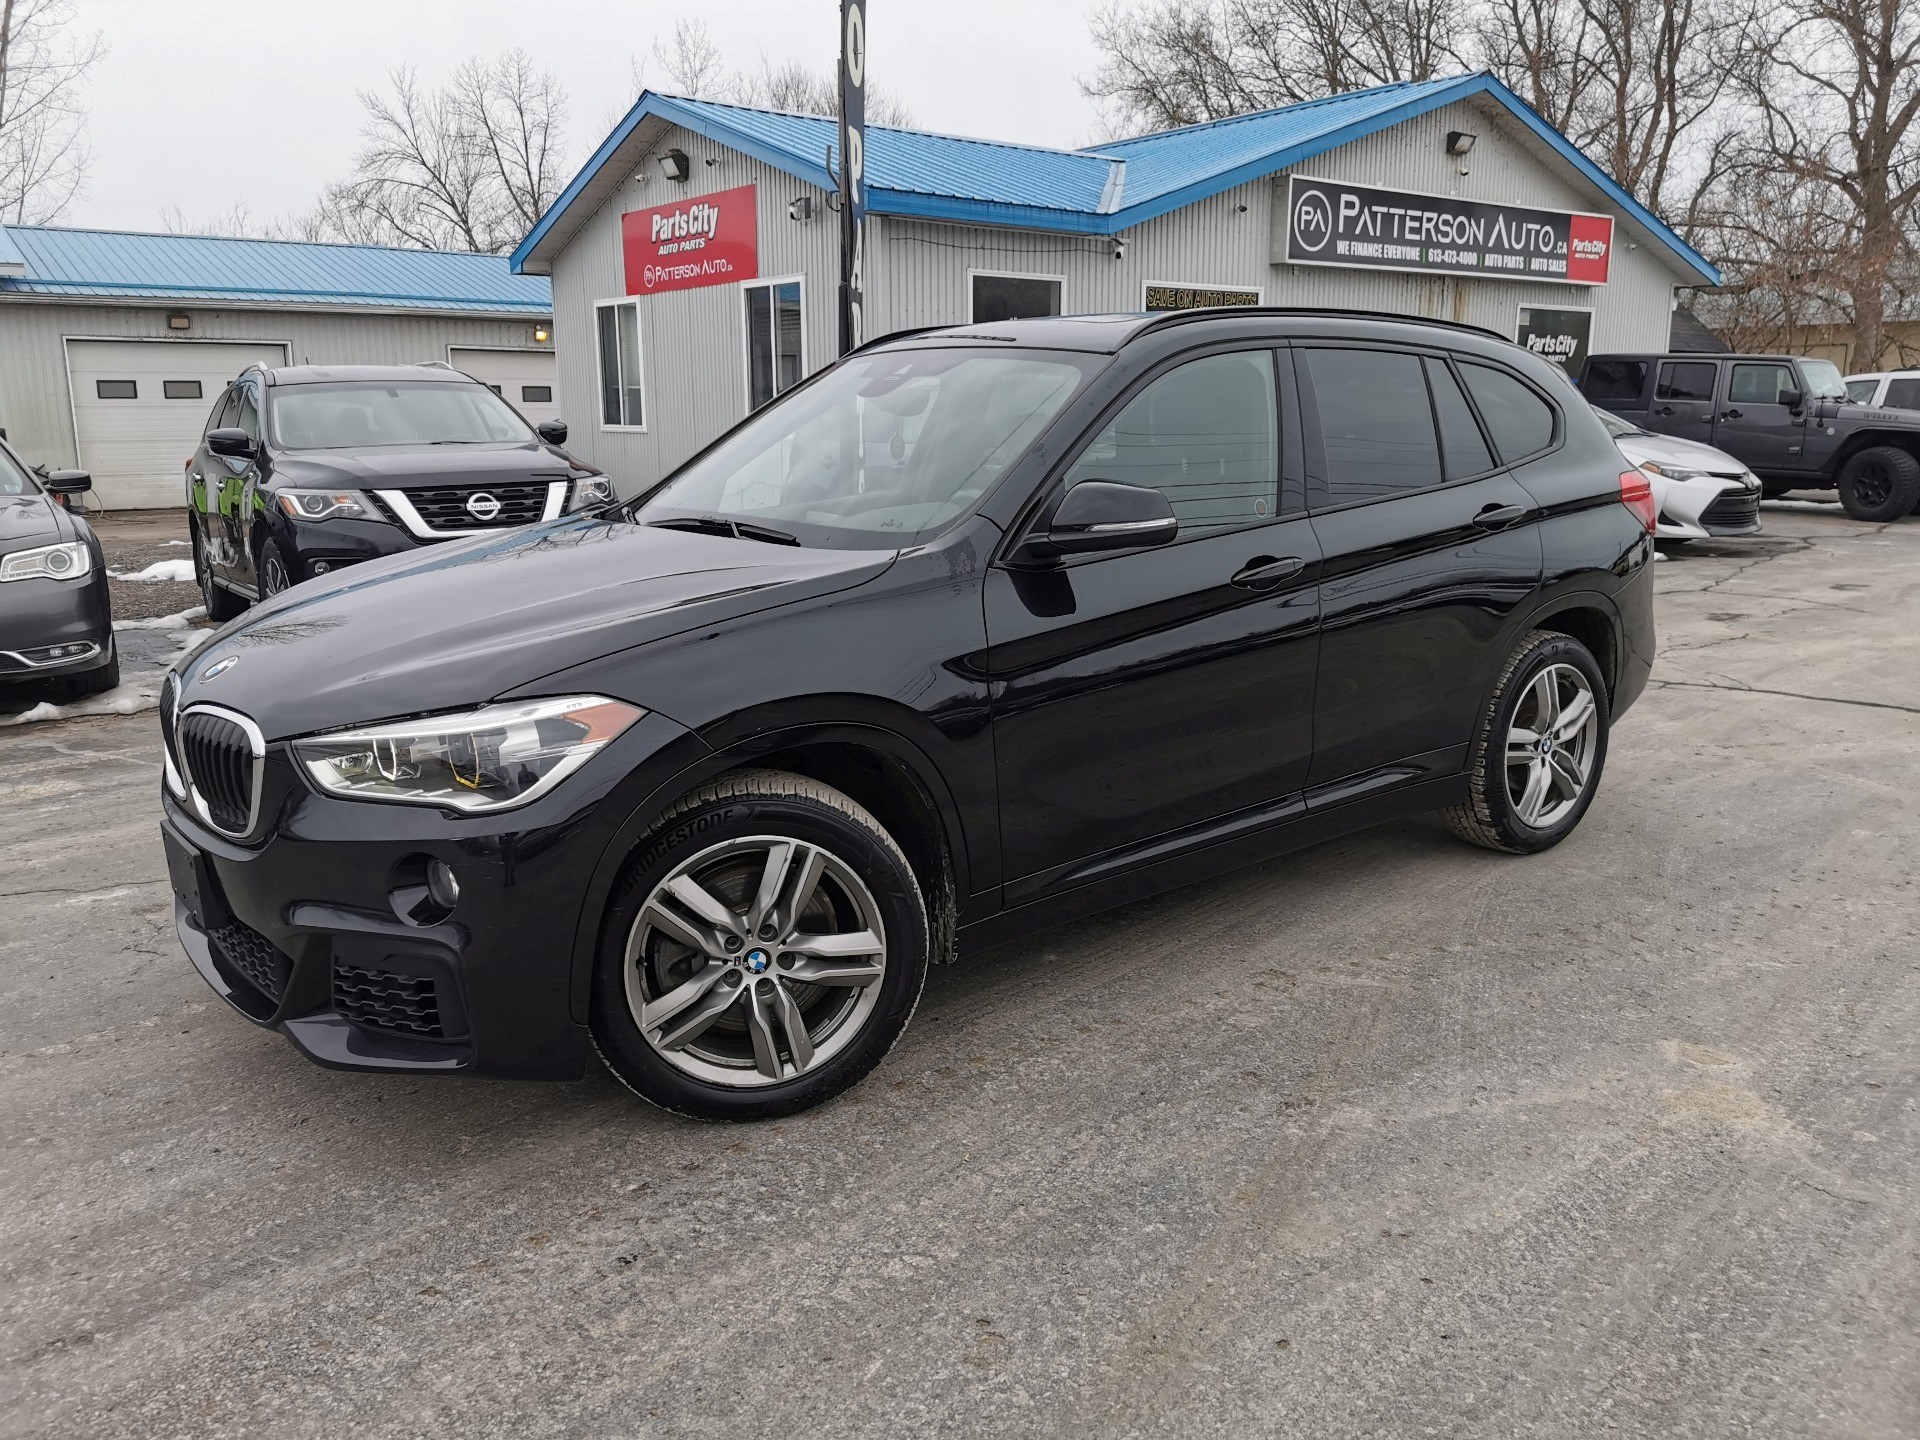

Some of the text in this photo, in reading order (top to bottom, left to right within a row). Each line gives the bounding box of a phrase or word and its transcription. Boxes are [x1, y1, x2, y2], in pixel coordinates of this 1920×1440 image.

[651, 203, 719, 243] PartsCity
[1300, 206, 1326, 232] PA
[1338, 193, 1485, 247] PATTERSON
[657, 237, 706, 257] AUTO PARTS
[1336, 240, 1420, 261] WE FINANCE EVERYONE
[1428, 248, 1478, 266] 613-473-4000
[1572, 238, 1607, 256] PartsCity
[1484, 253, 1525, 270] AUTO PARTS
[1530, 257, 1567, 273] AUTO SALES
[655, 263, 701, 282] PATTERSON
[1177, 289, 1194, 308] ON
[1194, 290, 1223, 308] AUTO
[1224, 292, 1257, 306] PARTS
[1527, 333, 1578, 358] PartsCity
[624, 808, 734, 893] BRIDGESTONE
